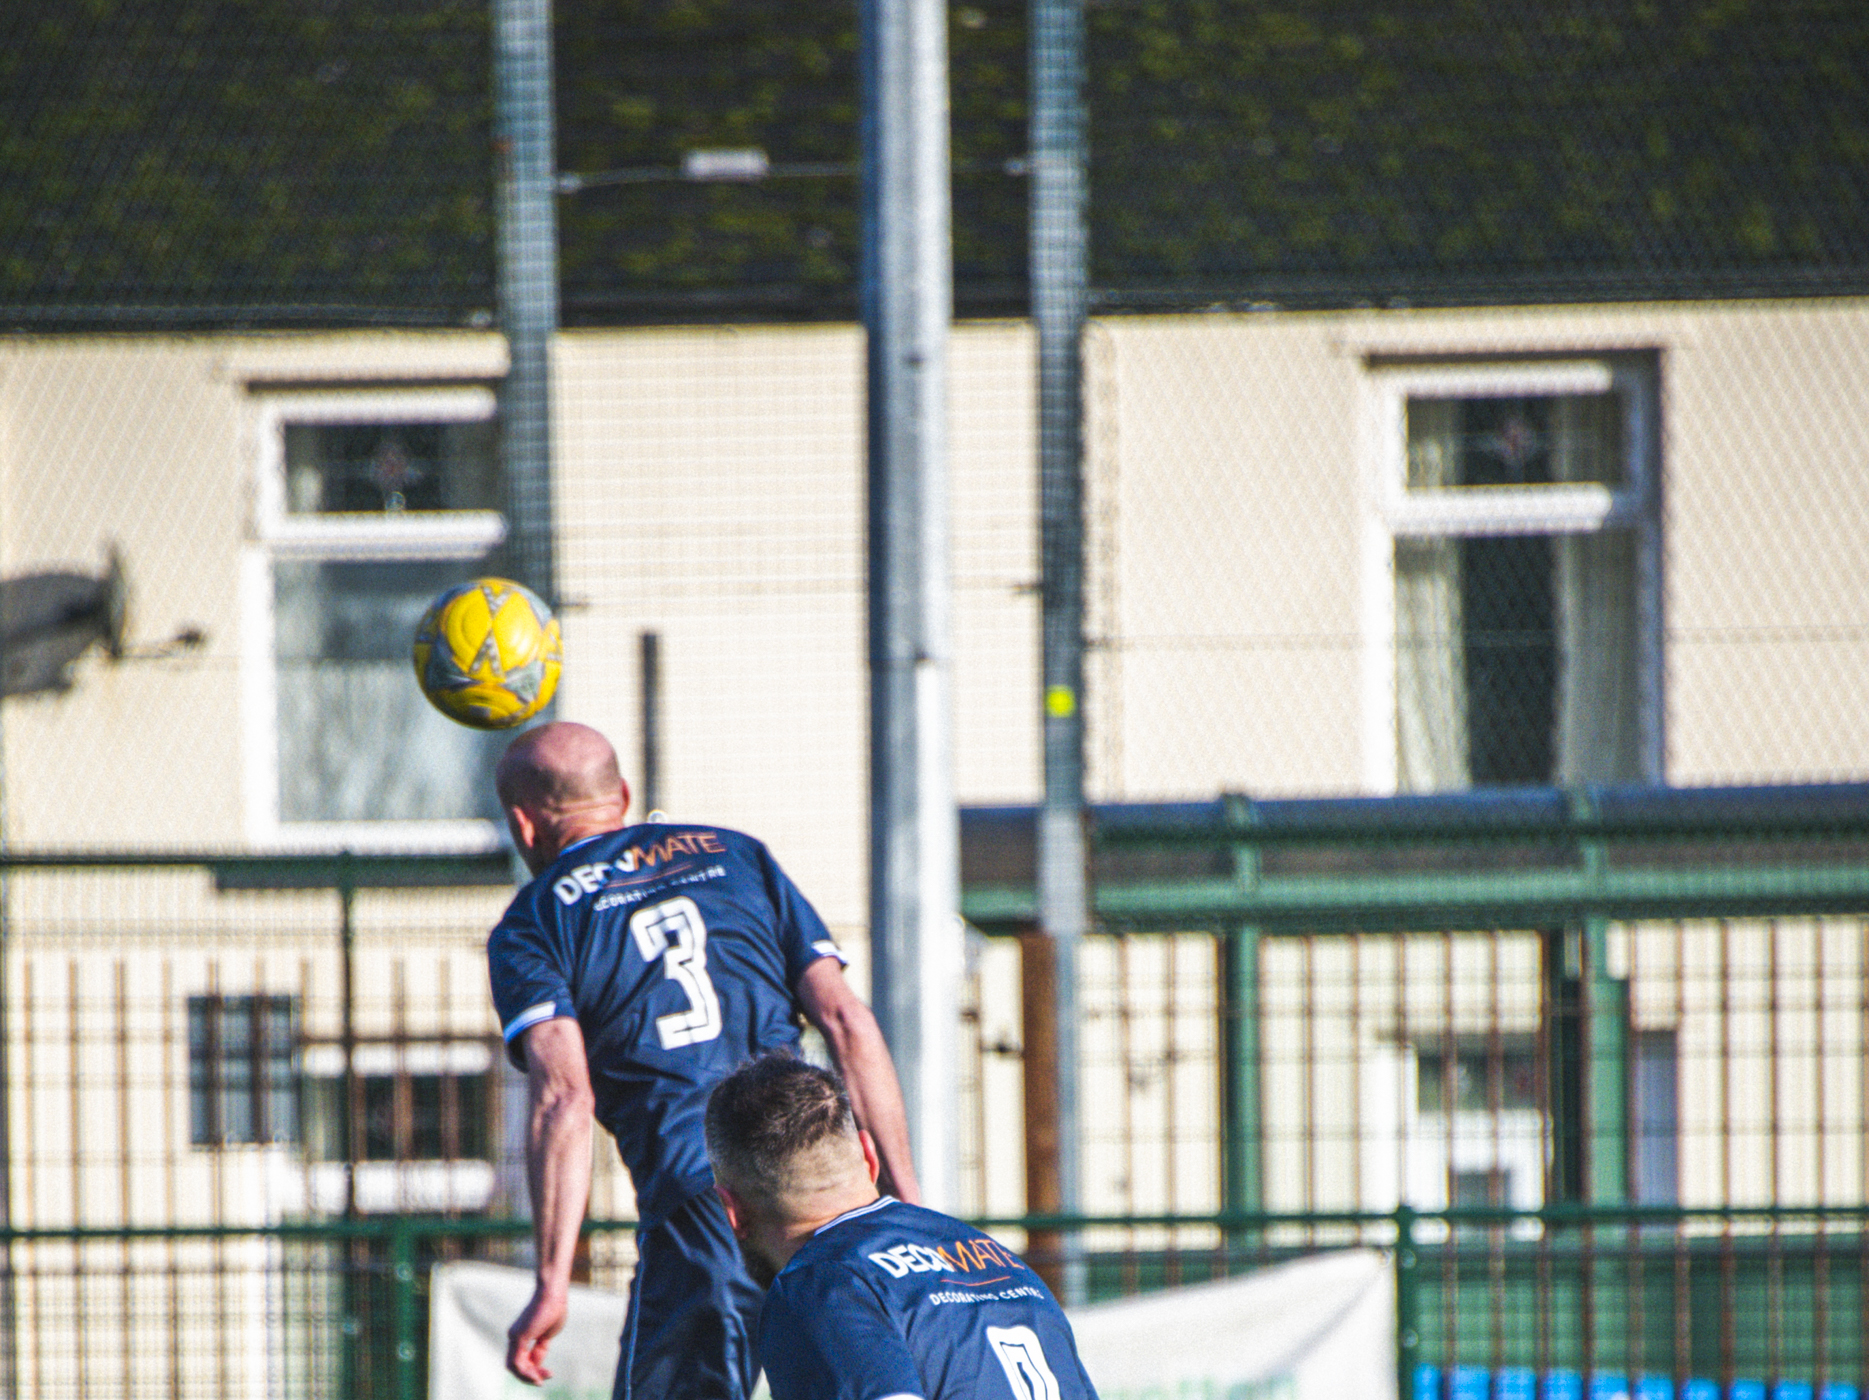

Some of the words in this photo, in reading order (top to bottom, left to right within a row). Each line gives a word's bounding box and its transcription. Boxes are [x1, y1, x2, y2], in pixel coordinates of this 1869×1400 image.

[629, 895, 723, 1051] 3
[868, 1239, 1025, 1278] DECOMATE
[928, 1291, 1000, 1306] DECORATING
